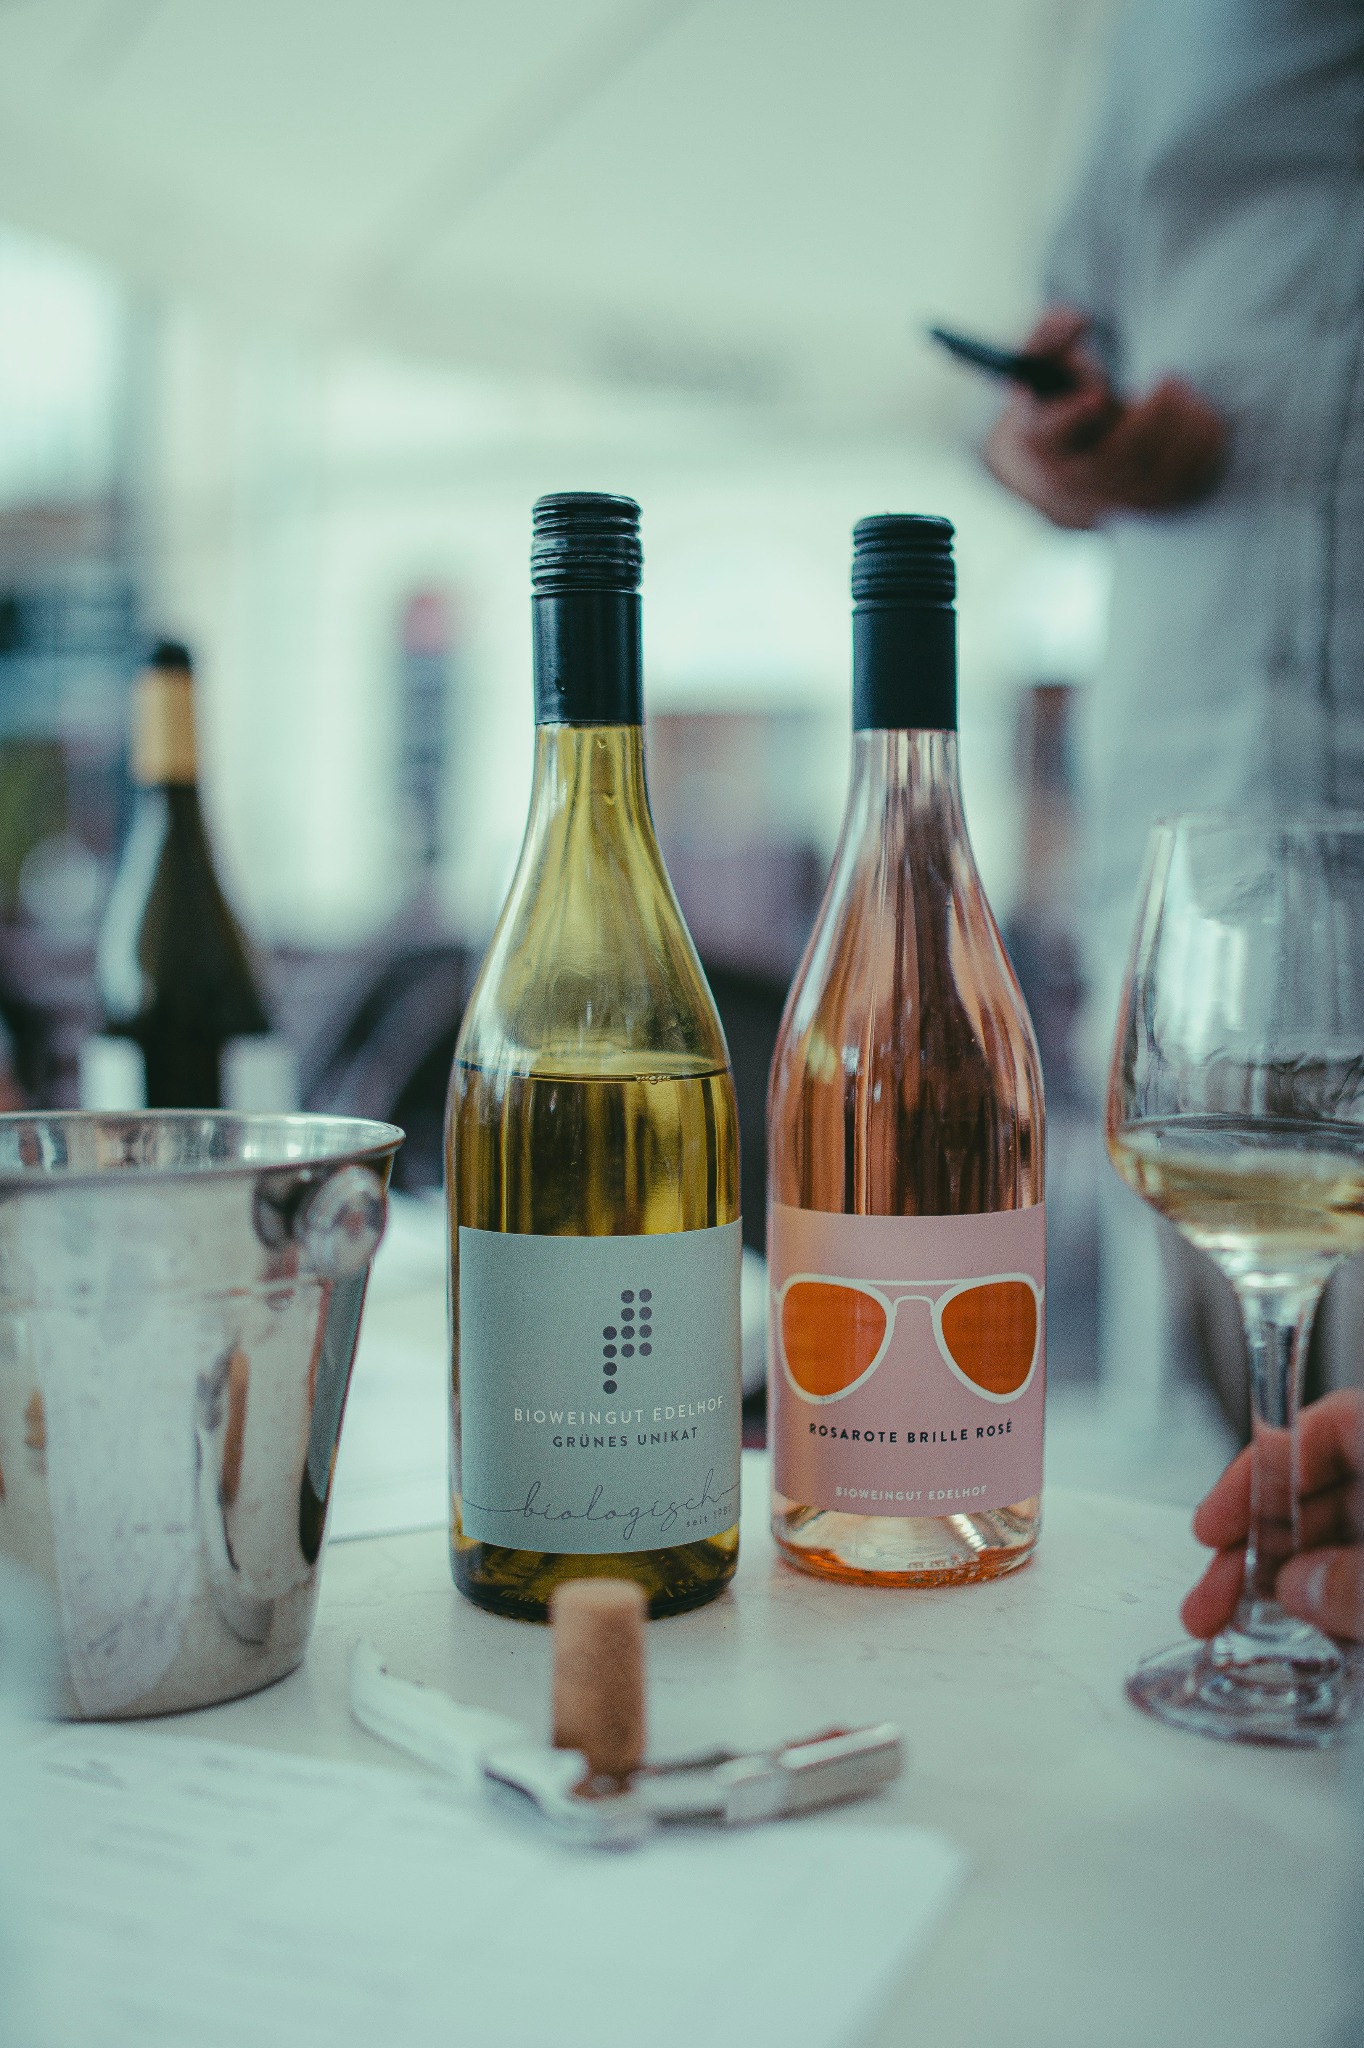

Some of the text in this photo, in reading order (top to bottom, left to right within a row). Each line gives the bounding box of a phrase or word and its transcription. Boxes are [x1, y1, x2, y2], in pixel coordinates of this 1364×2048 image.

[513, 1395, 725, 1425] BIOWEINGUT EDELHOF
[552, 1426, 699, 1448] GRÜNES UNIKAT
[809, 1418, 1012, 1443] ROSAROTE BRILLE ROSÉ
[463, 1467, 740, 1541] biologisch
[835, 1484, 988, 1501] BIOWEINGUT EDELHOF
[686, 1515, 708, 1528] seit
